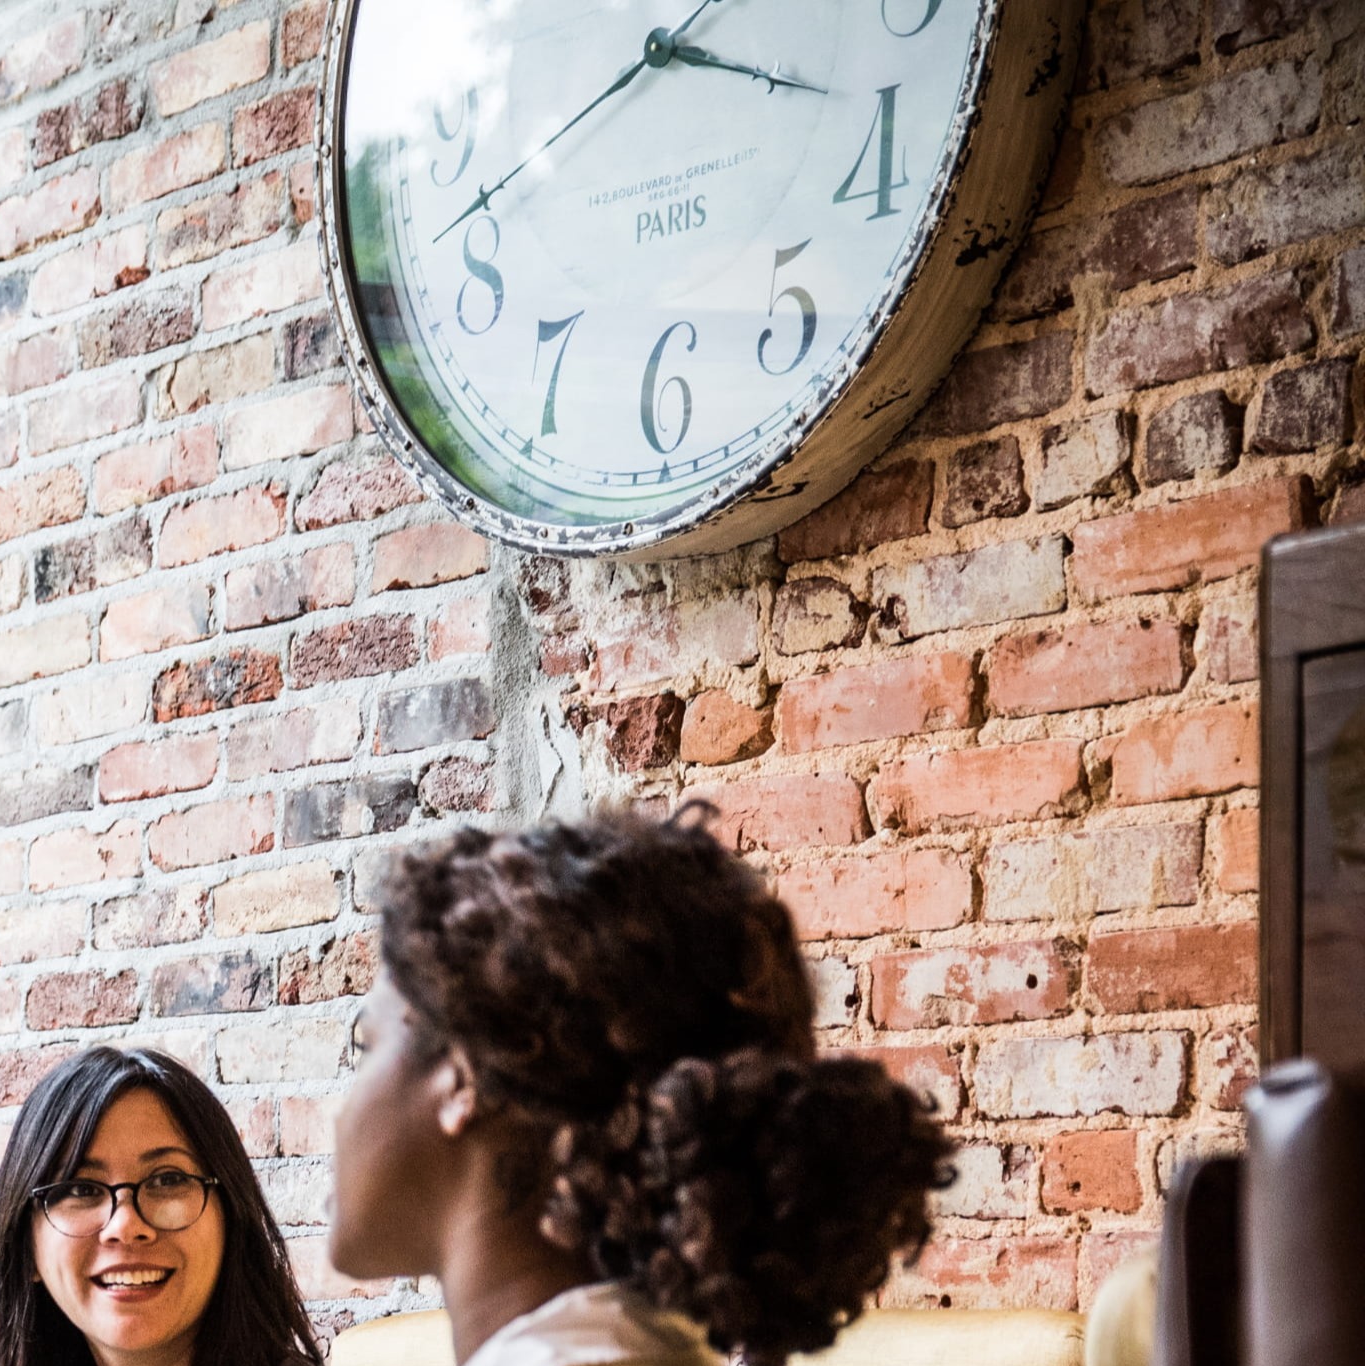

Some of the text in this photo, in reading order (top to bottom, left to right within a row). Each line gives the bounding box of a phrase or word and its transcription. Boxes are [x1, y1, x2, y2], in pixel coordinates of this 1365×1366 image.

[831, 82, 910, 222] 4
[456, 214, 505, 336] 8
[636, 194, 708, 244] PARIS
[757, 237, 818, 376] 5
[531, 309, 586, 438] 7
[640, 320, 698, 454] 6
